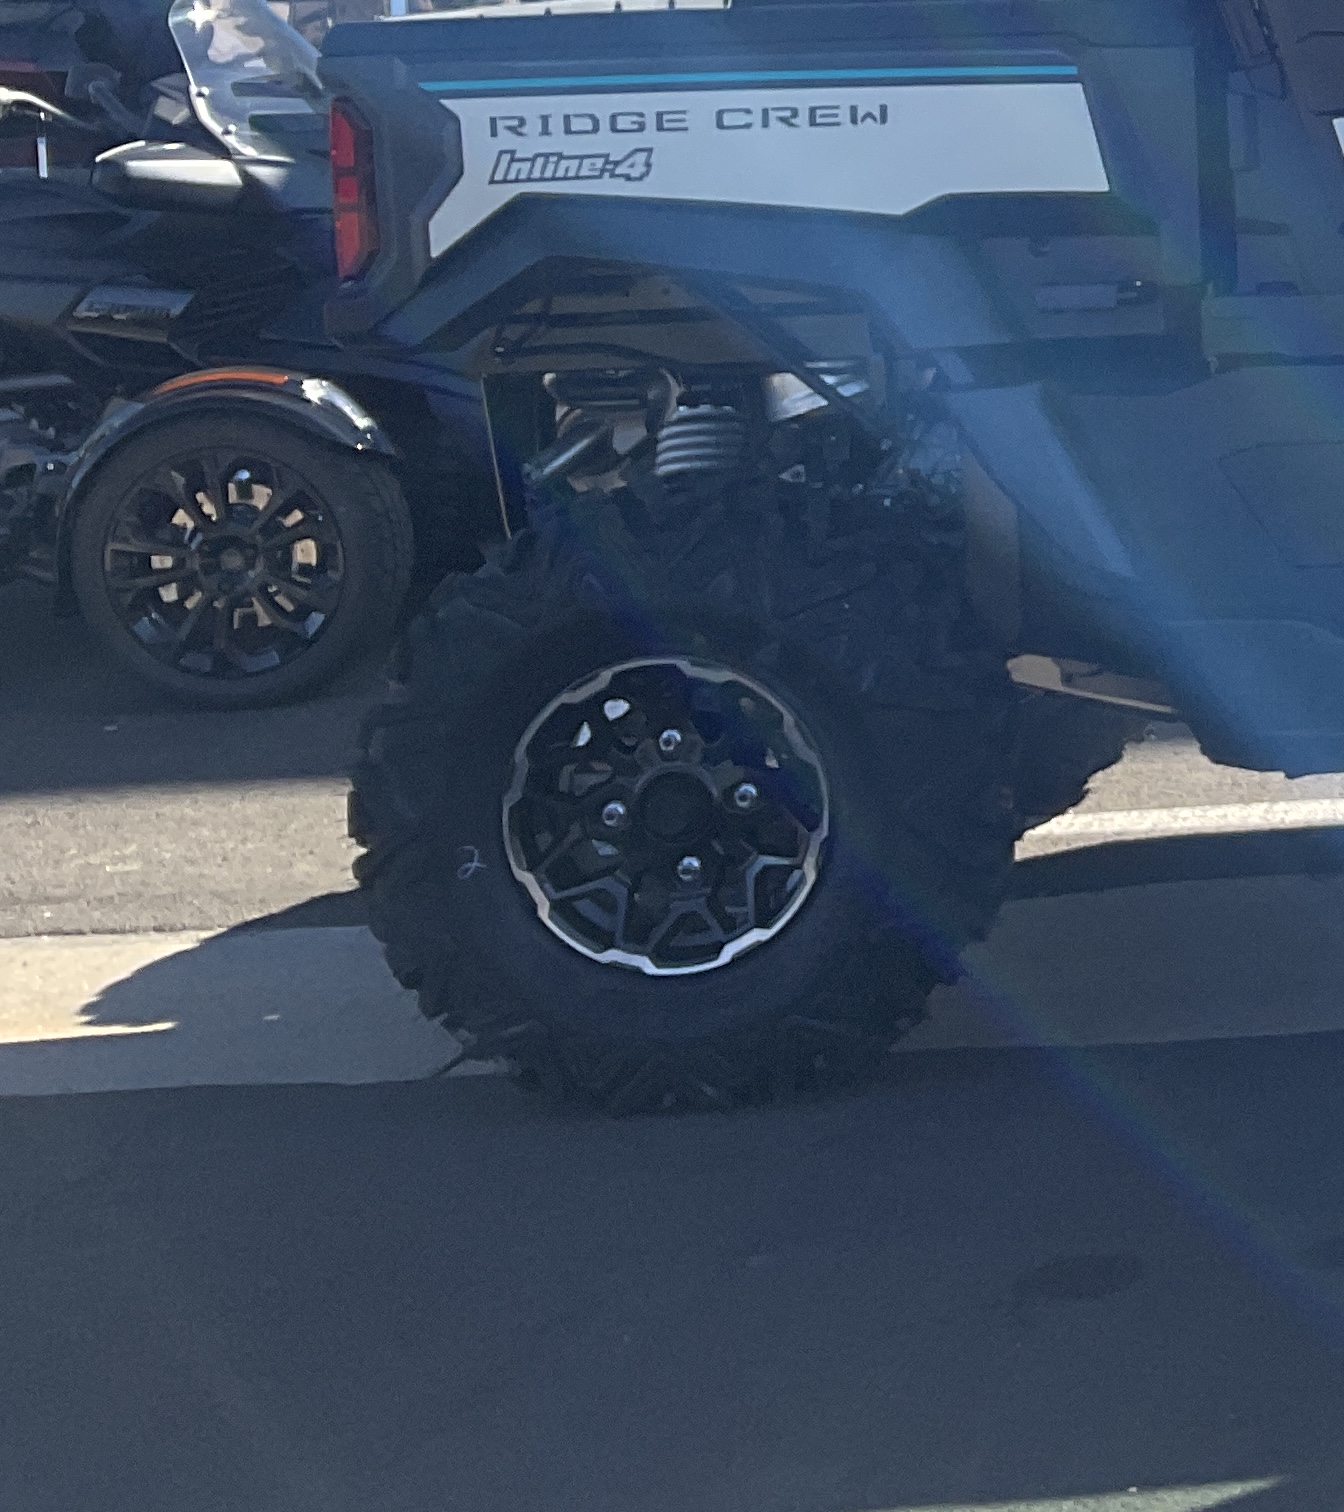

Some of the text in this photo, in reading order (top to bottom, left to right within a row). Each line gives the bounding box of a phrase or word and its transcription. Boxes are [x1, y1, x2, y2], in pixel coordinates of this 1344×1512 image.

[489, 103, 889, 139] RIDGE CREW
[488, 146, 654, 186] Inline-4
